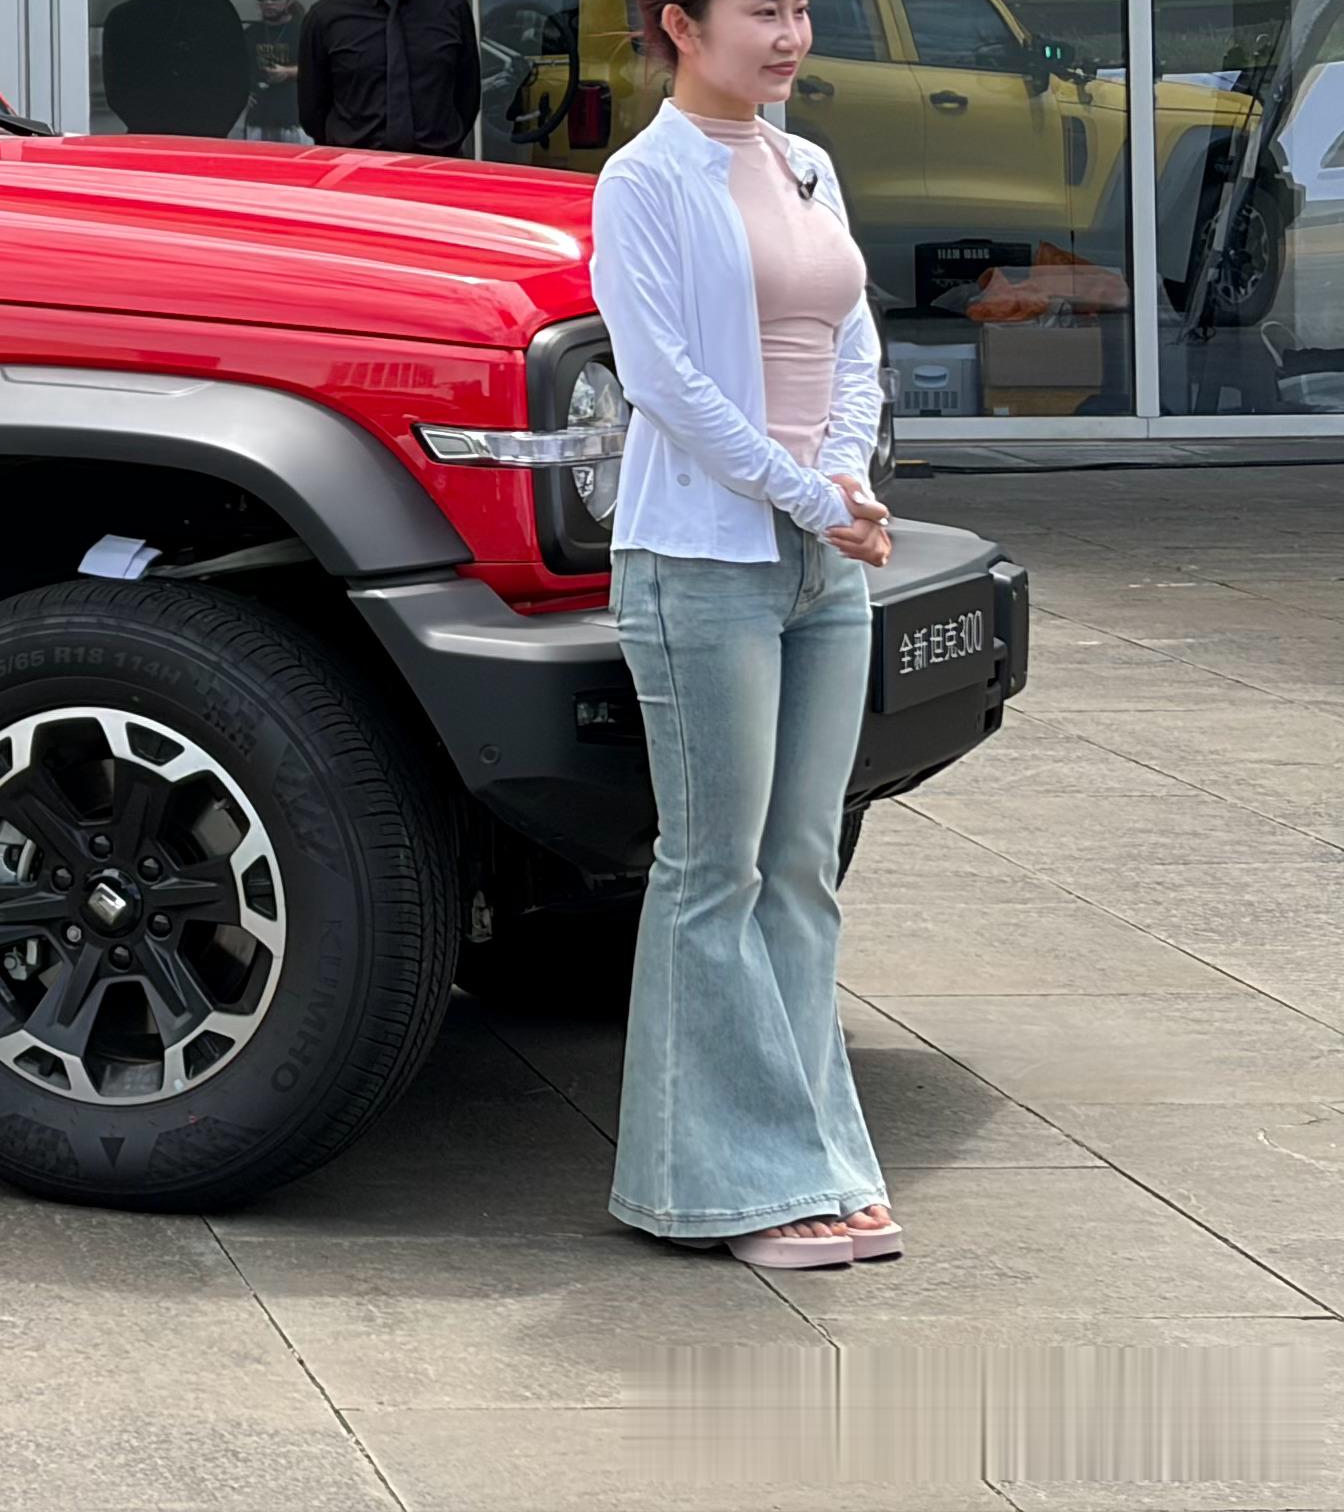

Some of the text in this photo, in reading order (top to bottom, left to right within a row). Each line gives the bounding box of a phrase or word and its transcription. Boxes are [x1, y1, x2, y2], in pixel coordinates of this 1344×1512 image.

[113, 651, 182, 685] 114H
[898, 609, 983, 675] 全新坦克300
[270, 918, 345, 1094] KUMHO
